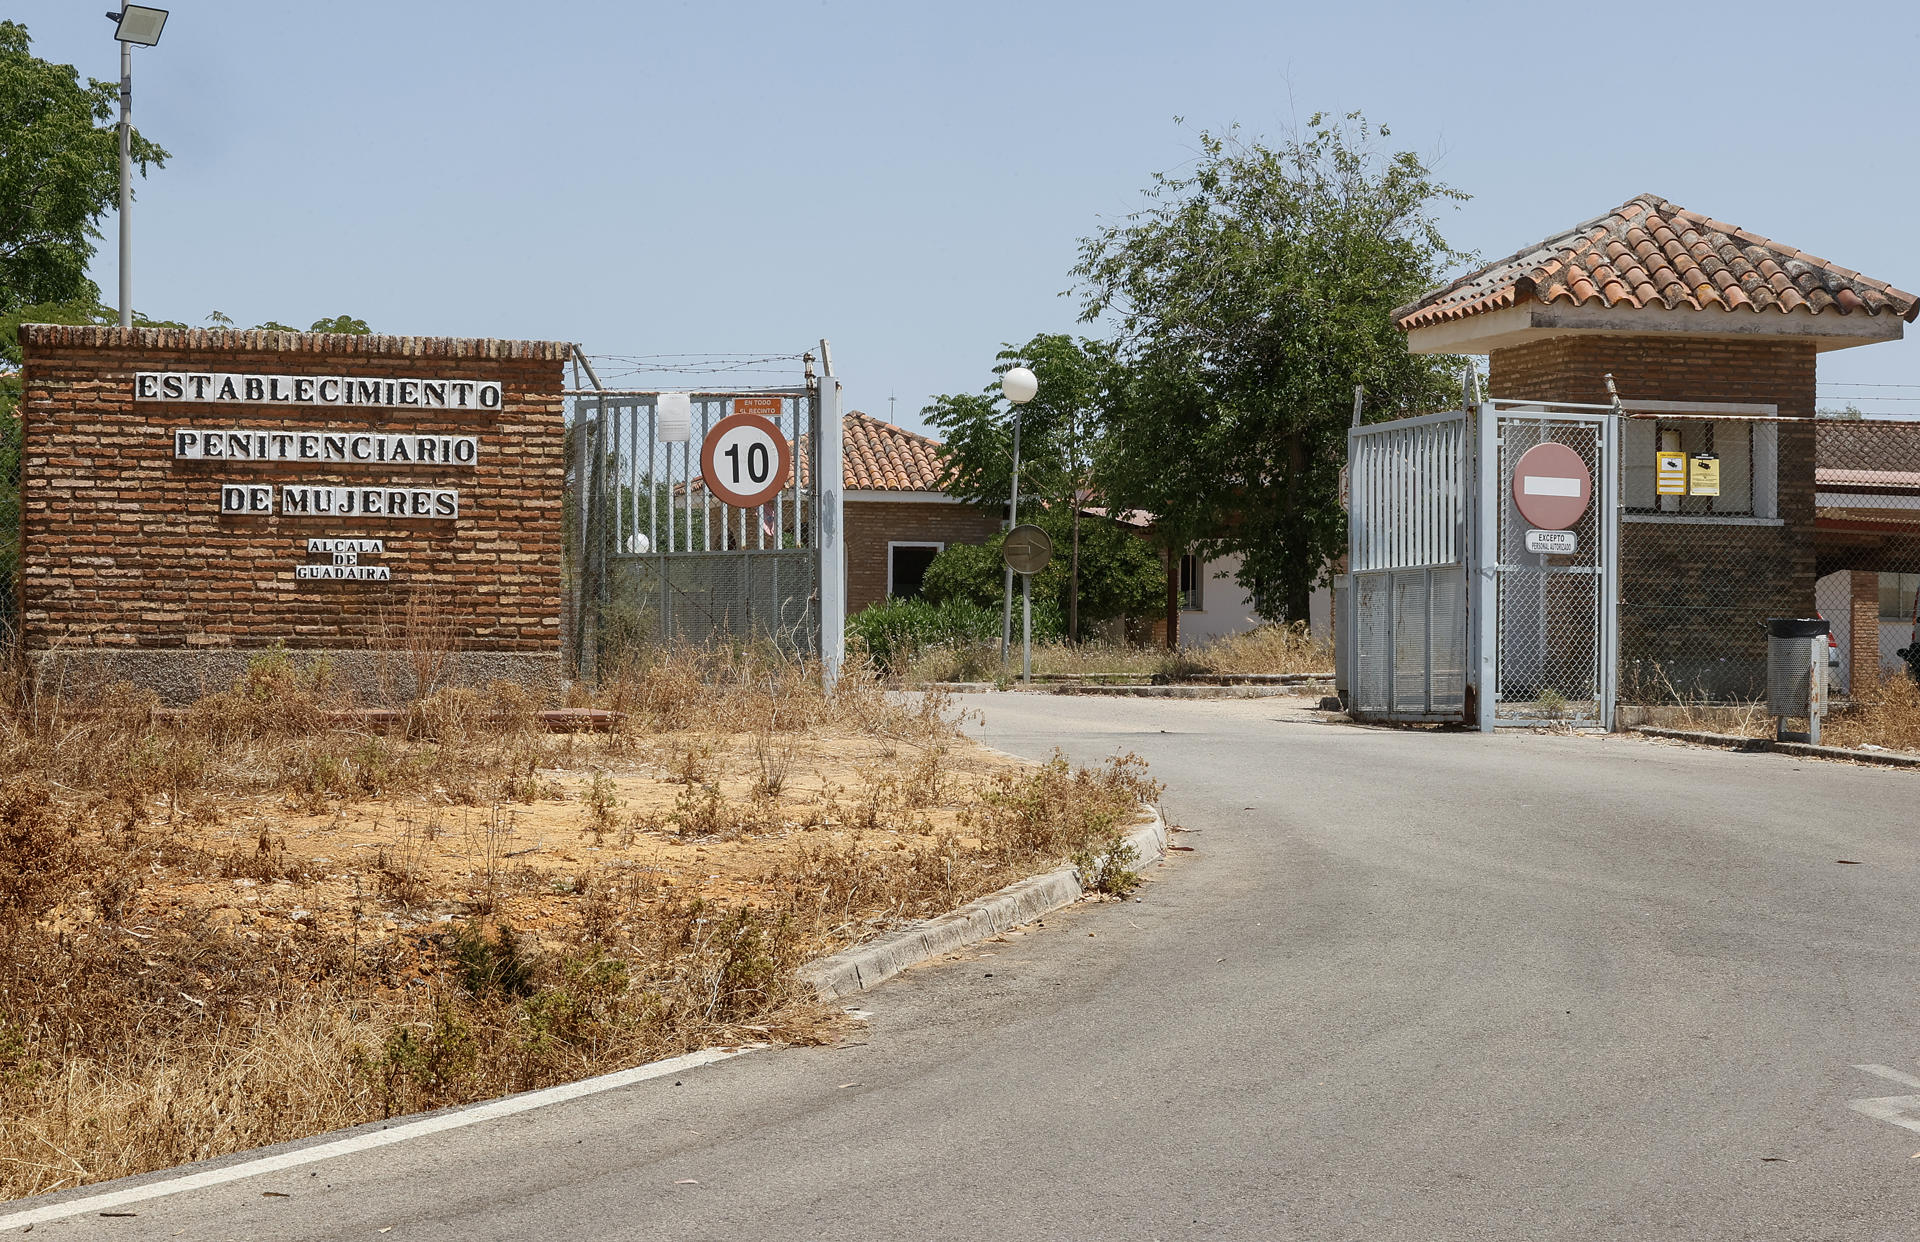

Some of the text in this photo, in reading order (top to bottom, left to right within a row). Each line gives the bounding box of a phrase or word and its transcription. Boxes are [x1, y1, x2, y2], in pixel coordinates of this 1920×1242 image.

[138, 375, 500, 408] ESTABLECIMIENTO
[177, 433, 476, 463] PENITENCIARIO
[725, 443, 769, 484] 10
[224, 488, 456, 516] DE MUJERES
[310, 541, 380, 552] ALCALA
[1538, 533, 1565, 542] EXCEPTO
[335, 554, 356, 565] DE
[297, 567, 388, 579] GUADAIRA
